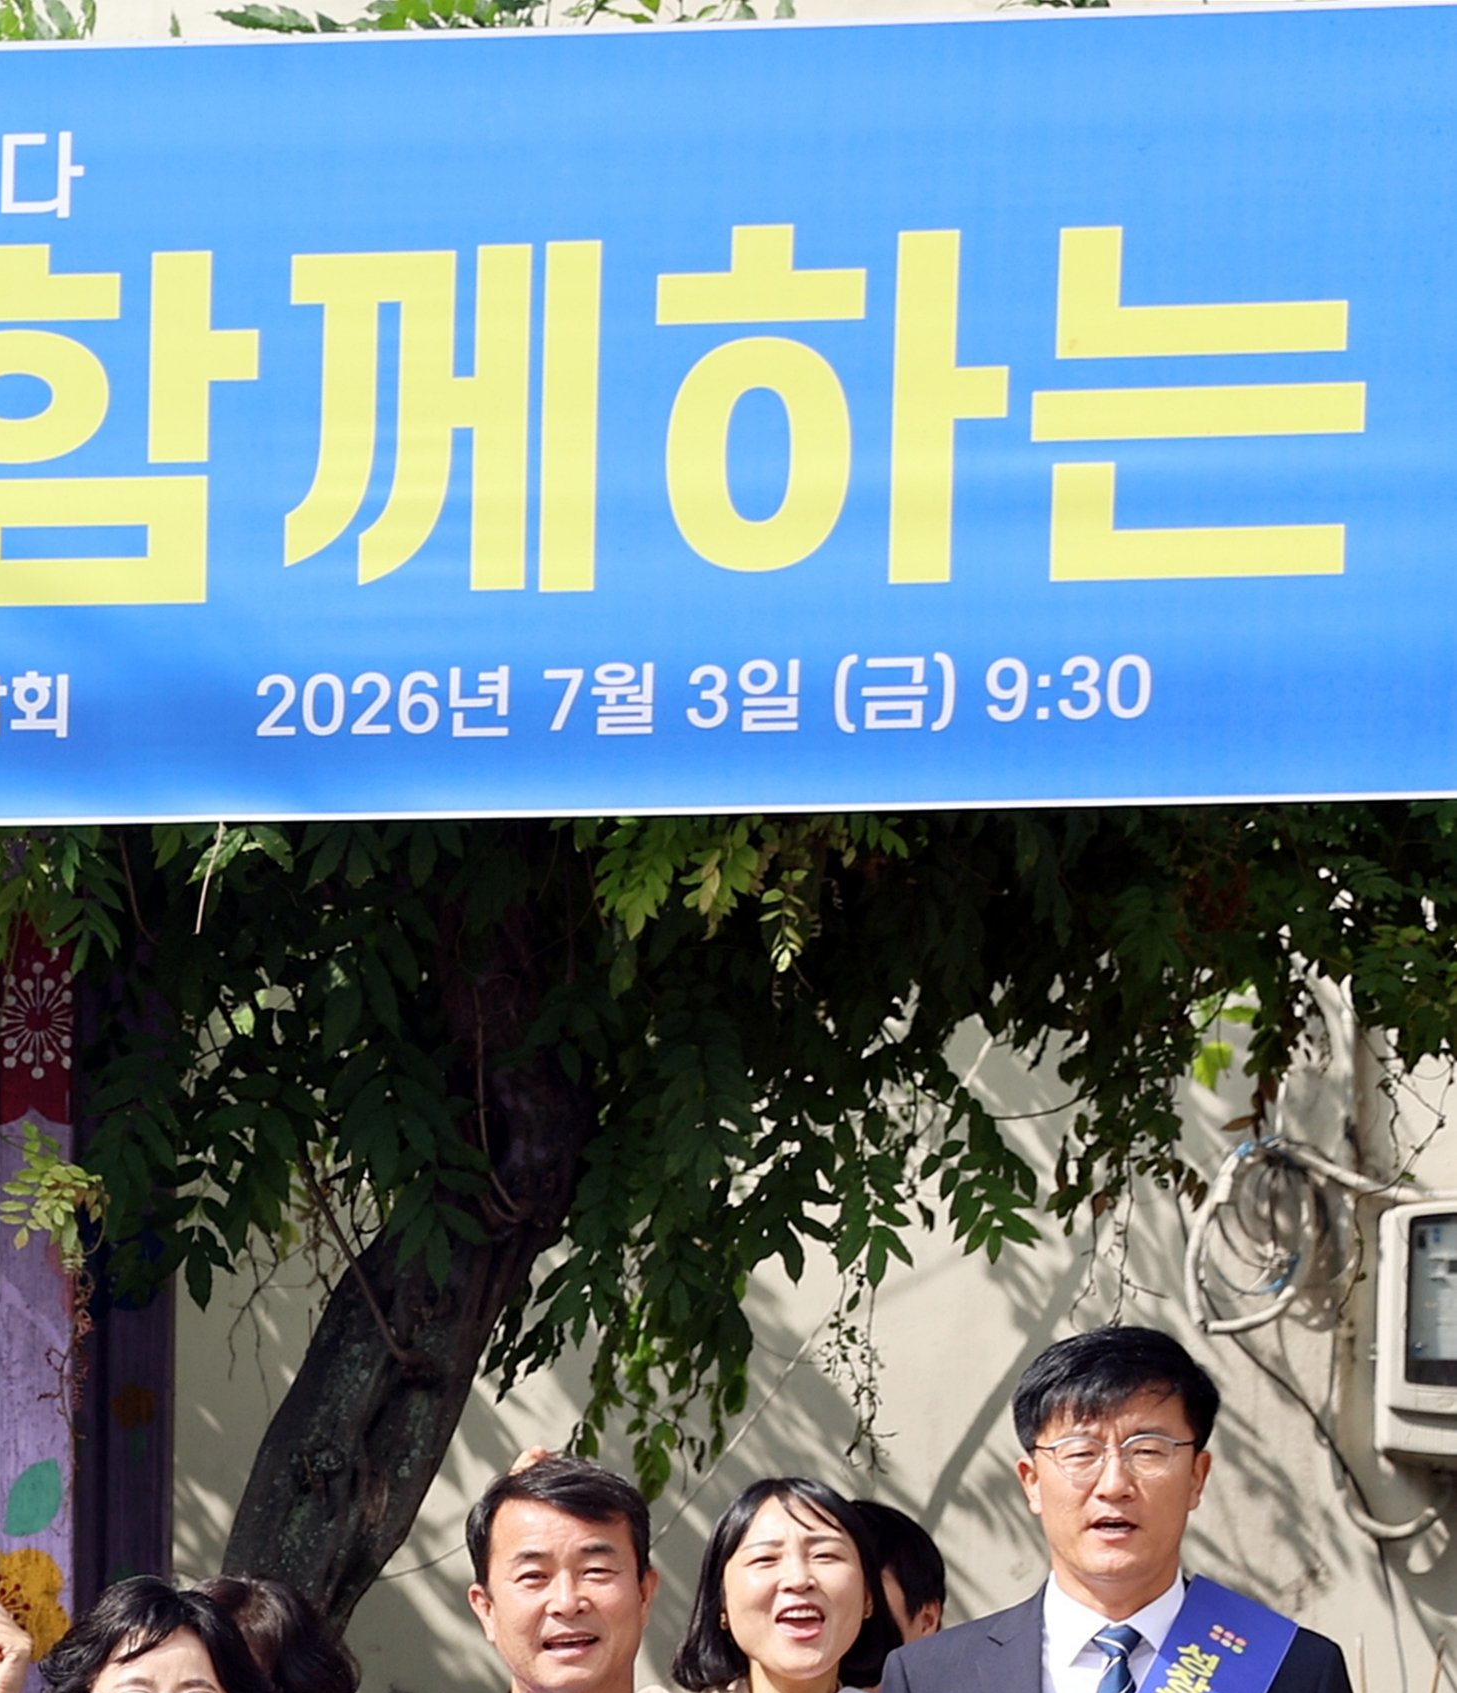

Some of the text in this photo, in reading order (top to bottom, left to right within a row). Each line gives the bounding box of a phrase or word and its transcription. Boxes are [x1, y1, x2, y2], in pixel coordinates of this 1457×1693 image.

[256, 651, 1152, 738] 2026년 7월 3일 (금) 9:30
